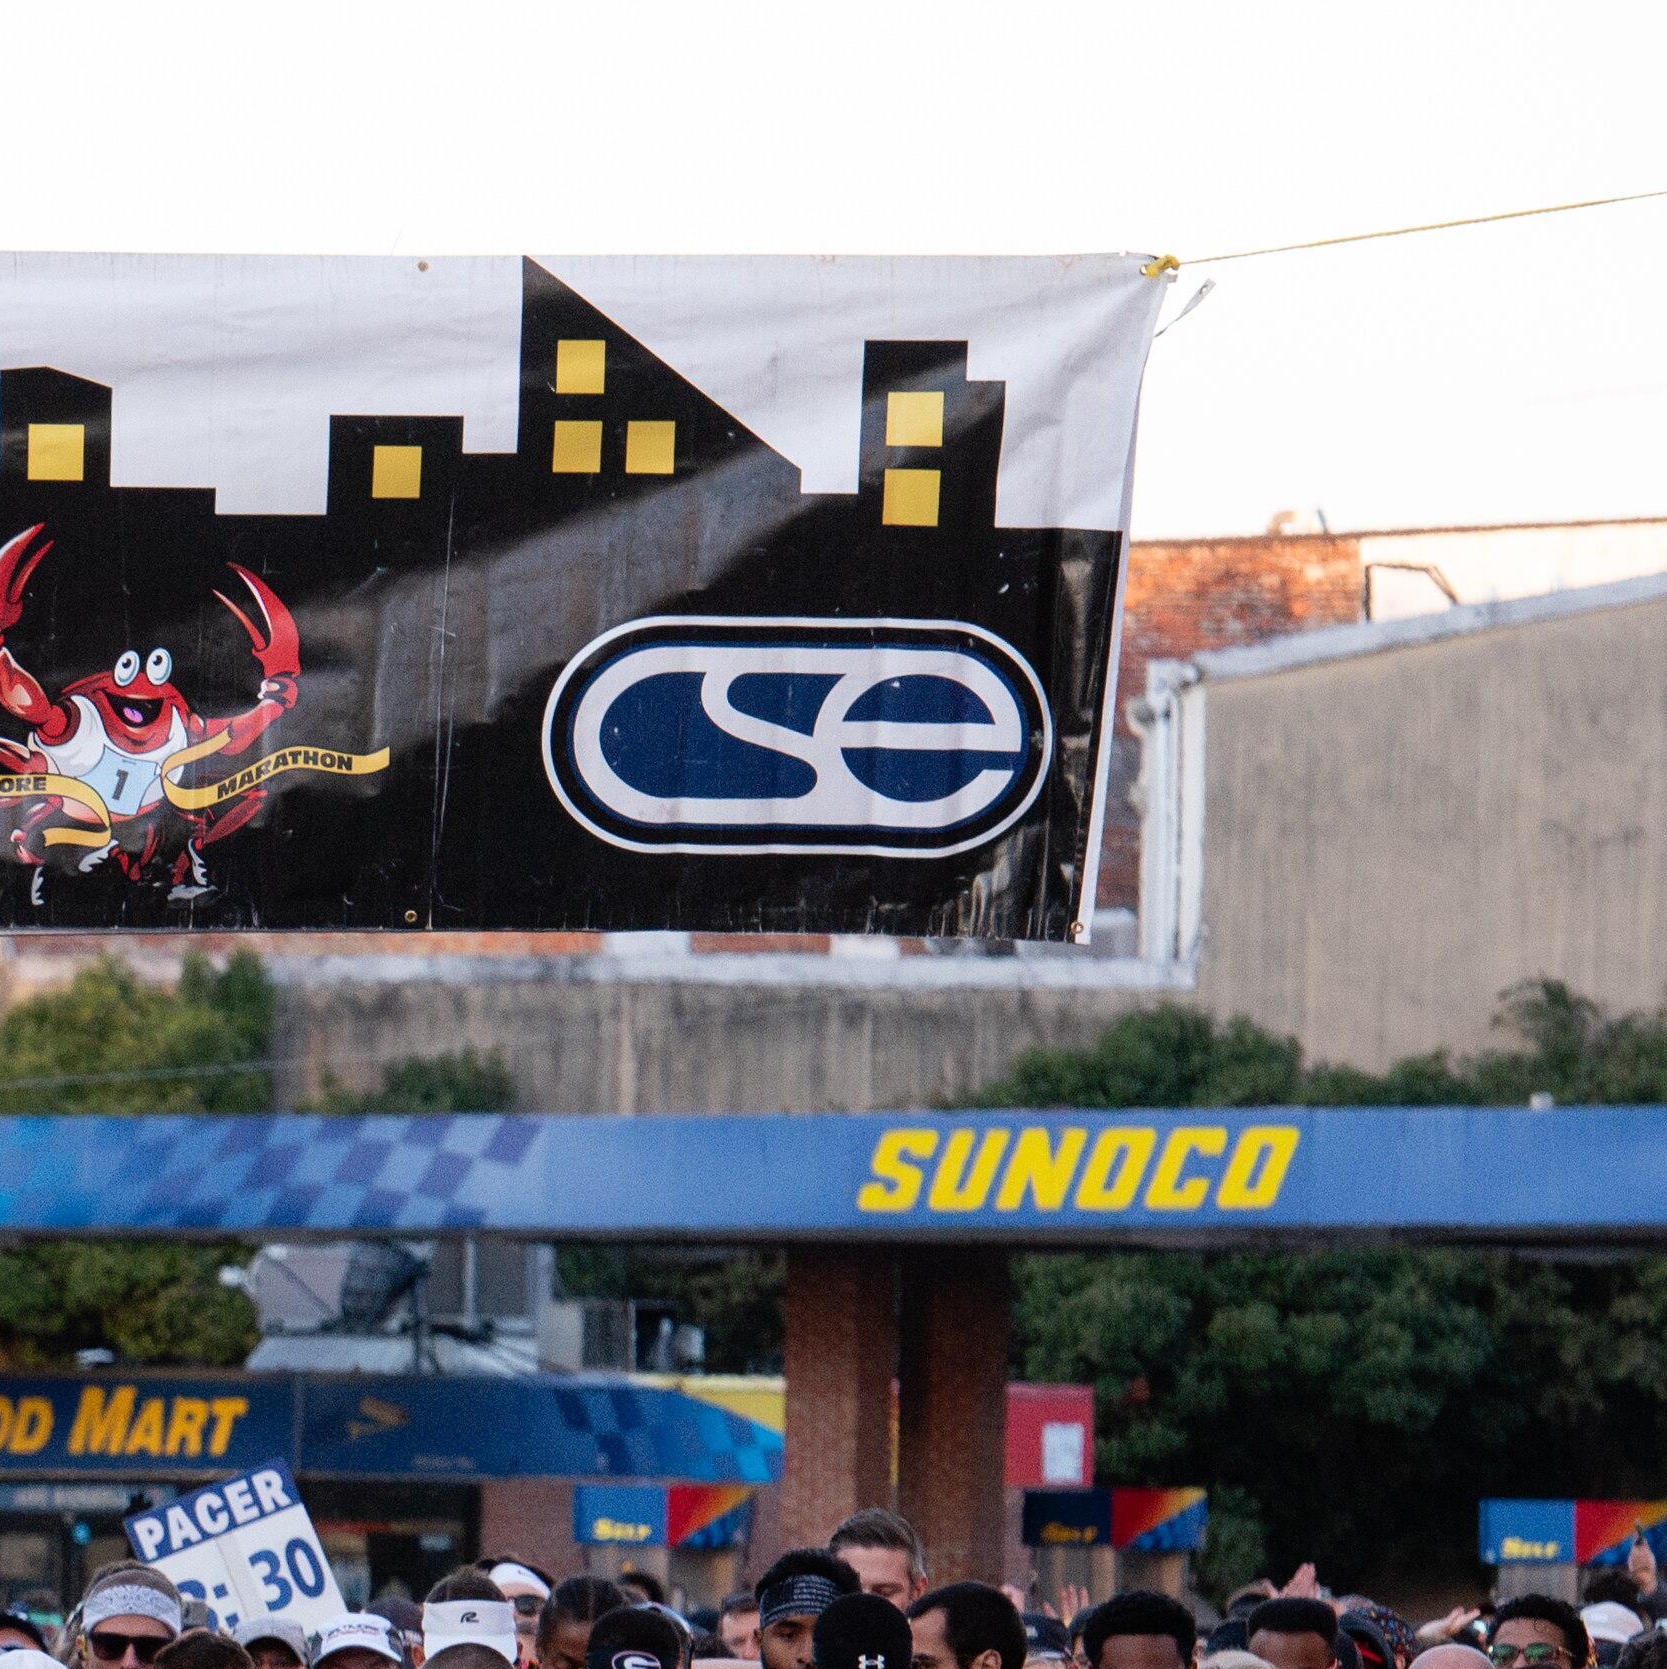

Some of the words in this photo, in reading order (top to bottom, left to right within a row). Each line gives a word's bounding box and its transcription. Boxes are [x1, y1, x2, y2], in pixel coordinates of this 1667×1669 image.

[111, 769, 129, 801] 1
[216, 749, 354, 801] MARATHON
[857, 1126, 1300, 1212] SUNOCO
[67, 1384, 248, 1457] MART
[133, 1468, 290, 1562] PACER
